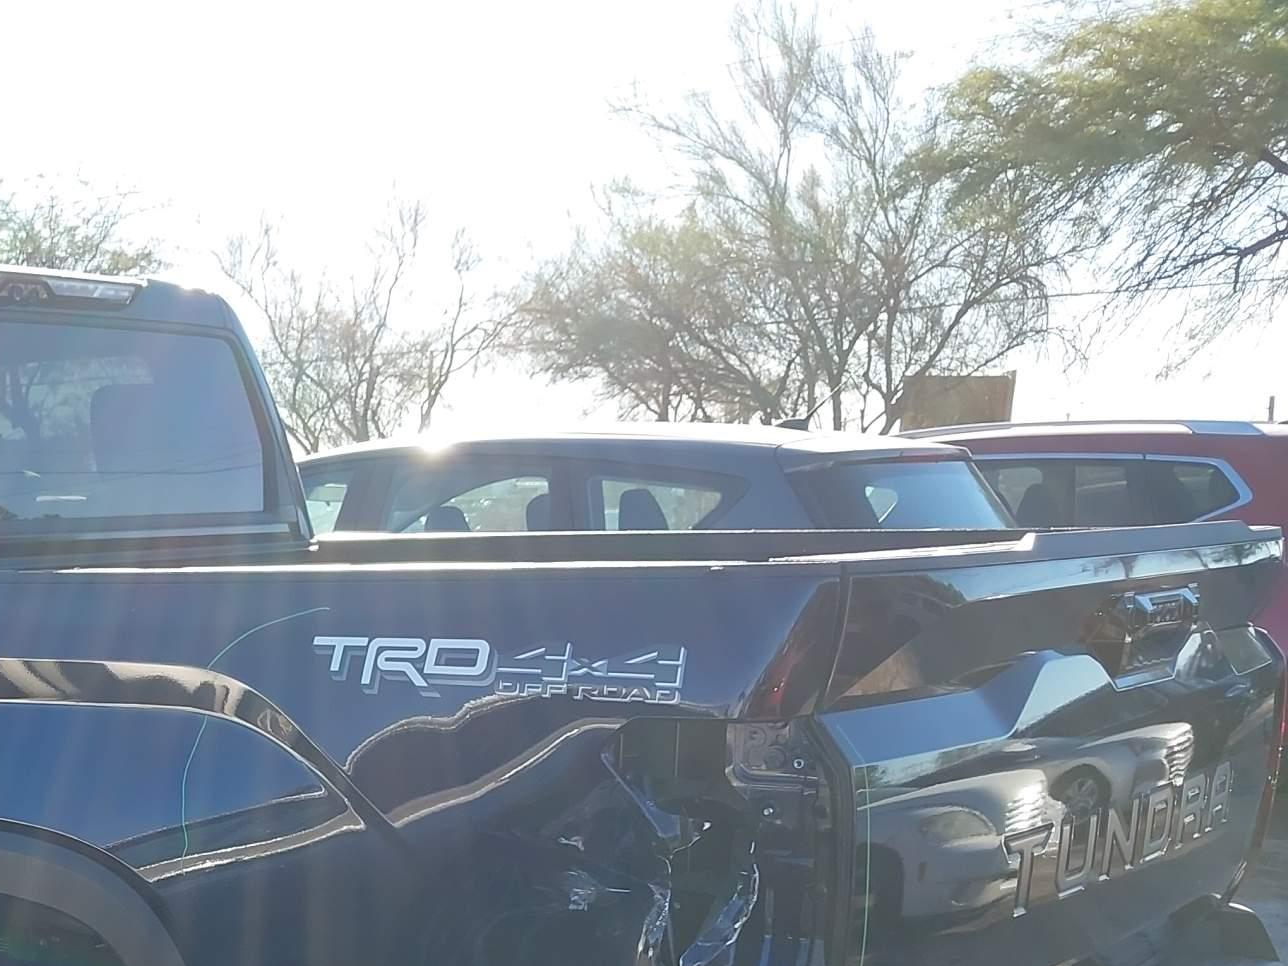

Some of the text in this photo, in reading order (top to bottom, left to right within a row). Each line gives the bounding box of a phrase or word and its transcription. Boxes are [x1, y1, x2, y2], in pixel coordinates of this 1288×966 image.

[312, 636, 686, 698] TRD 4x4
[495, 678, 682, 705] OFF ROAD
[1001, 761, 1234, 918] TUNDRA
